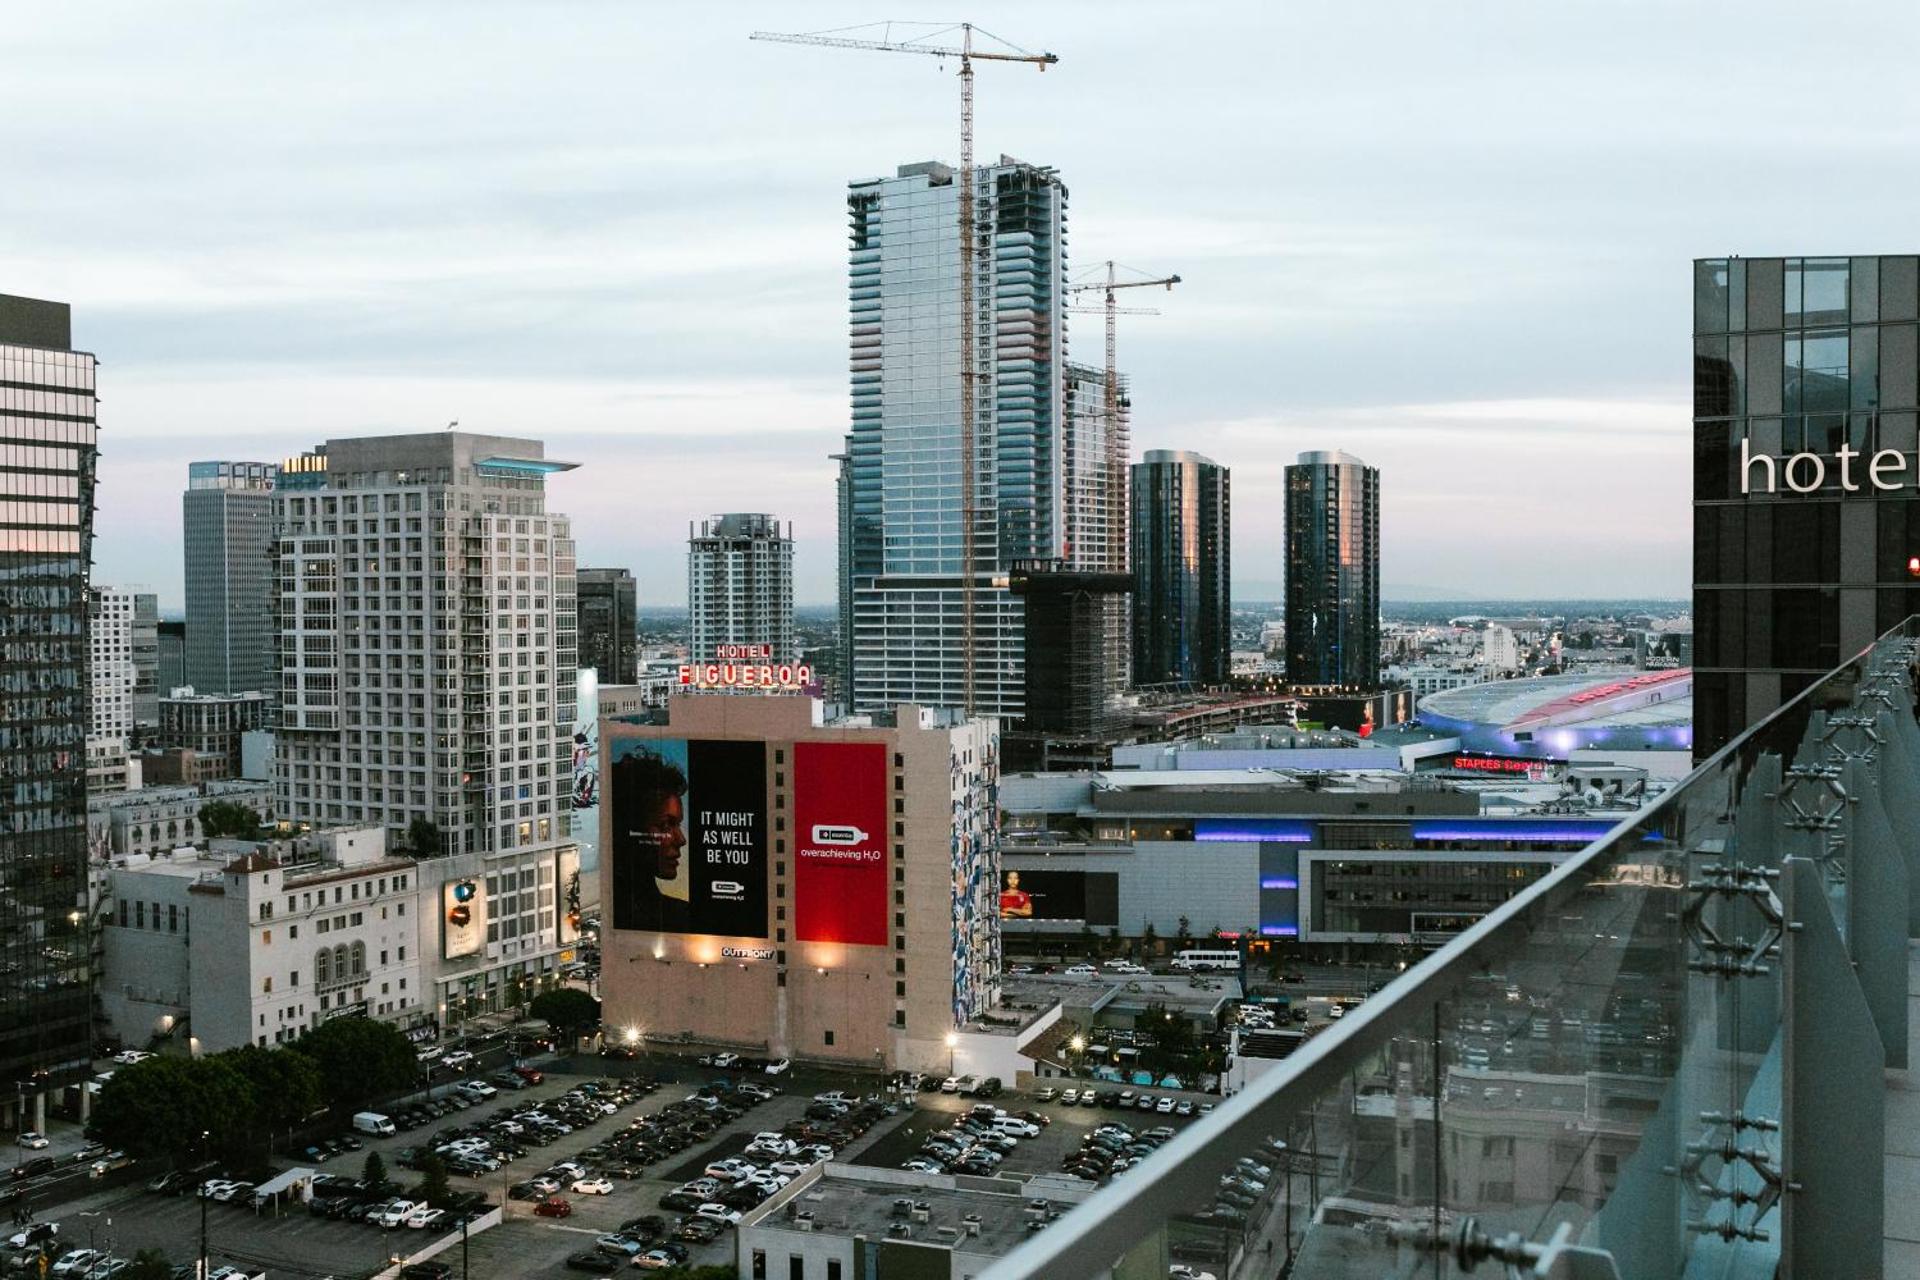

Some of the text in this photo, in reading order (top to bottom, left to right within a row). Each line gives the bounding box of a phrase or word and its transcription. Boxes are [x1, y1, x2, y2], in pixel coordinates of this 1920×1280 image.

[1741, 430, 1920, 494] hote
[717, 645, 769, 657] HOTEL
[679, 665, 810, 684] FIGUEROA
[1455, 758, 1501, 769] STAPLES
[701, 811, 754, 827] IT MIGHT
[703, 830, 753, 846] AS WELL
[707, 849, 749, 865] BE YOU
[800, 849, 861, 861] overachieving
